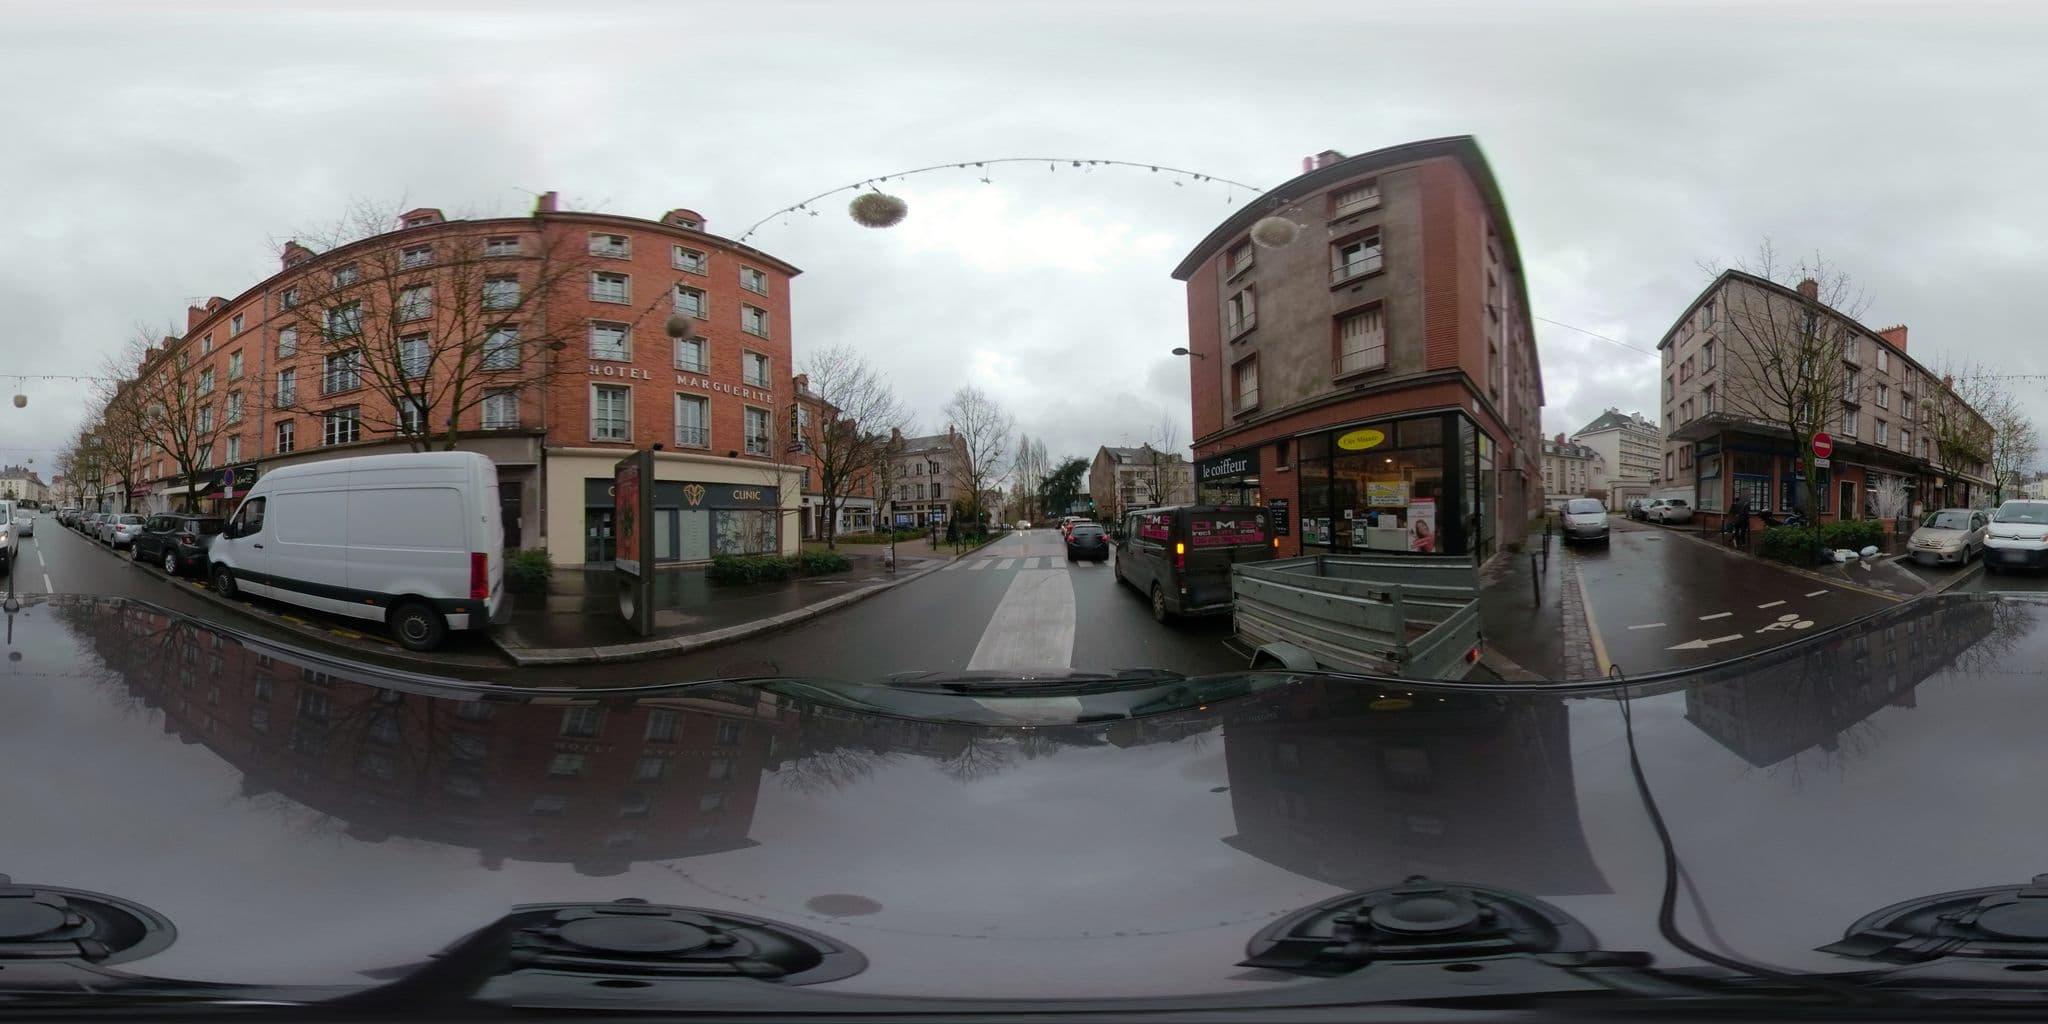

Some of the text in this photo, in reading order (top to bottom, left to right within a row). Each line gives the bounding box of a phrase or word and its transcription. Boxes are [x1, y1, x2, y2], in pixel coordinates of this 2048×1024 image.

[589, 364, 775, 404] HOTEL MARGUERITE
[1202, 457, 1248, 478] le coiffeur
[733, 490, 761, 501] CLINIC
